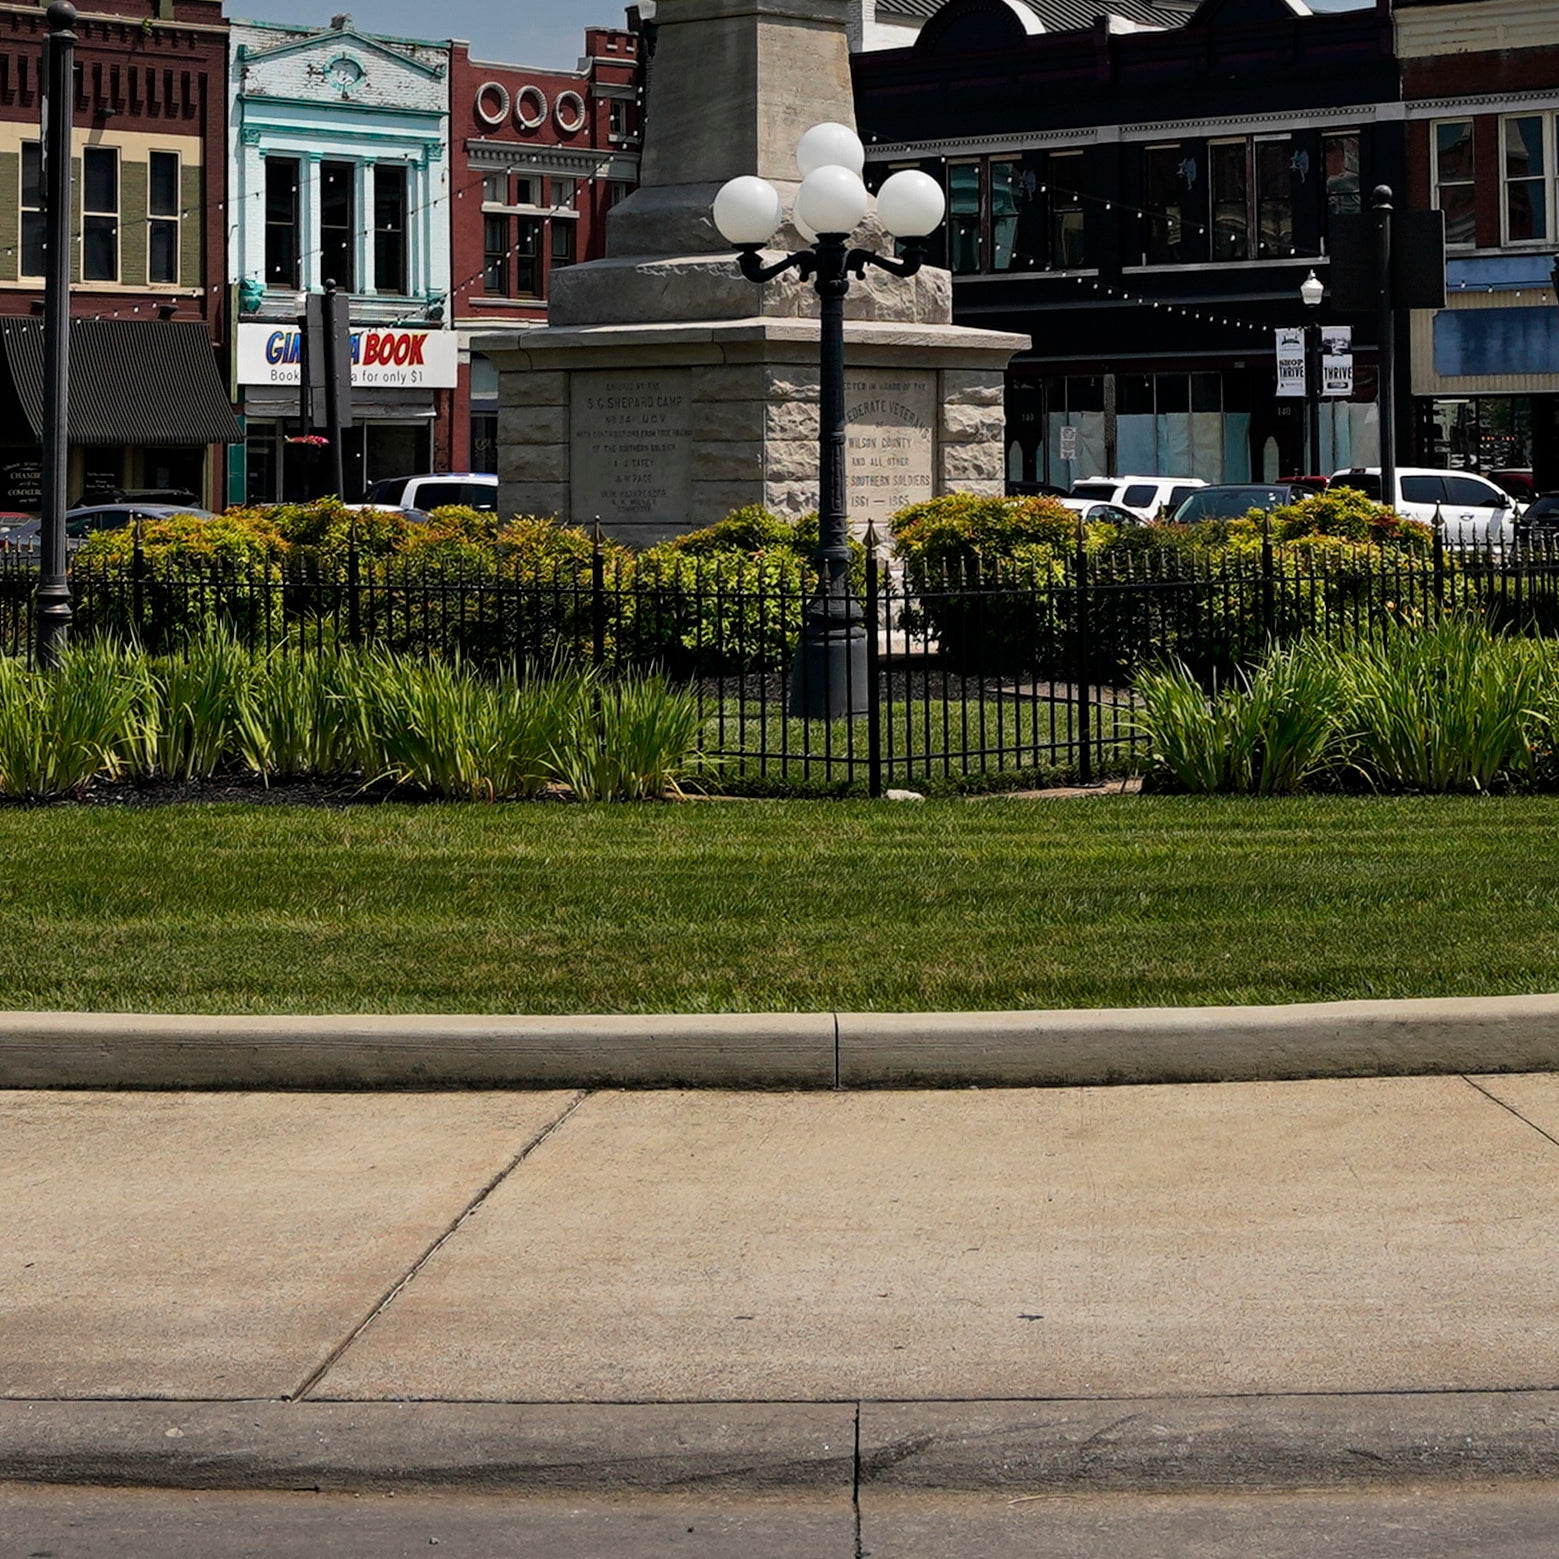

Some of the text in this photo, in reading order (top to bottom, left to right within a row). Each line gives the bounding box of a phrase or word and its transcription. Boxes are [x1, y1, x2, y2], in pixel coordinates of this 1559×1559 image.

[362, 333, 429, 366] BOOK
[362, 371, 378, 382] for
[383, 371, 406, 384] only
[410, 370, 423, 383] $1
[1324, 367, 1352, 380] THRIVE
[606, 396, 654, 409] SHEPARD
[656, 396, 683, 408] CAMP
[888, 401, 930, 441] VETERANS
[848, 437, 913, 450] WILSON COUNTY
[851, 457, 910, 467] AND ALL OTHER
[850, 475, 890, 487] SOUTHERN
[893, 475, 931, 486] SOLDIERS
